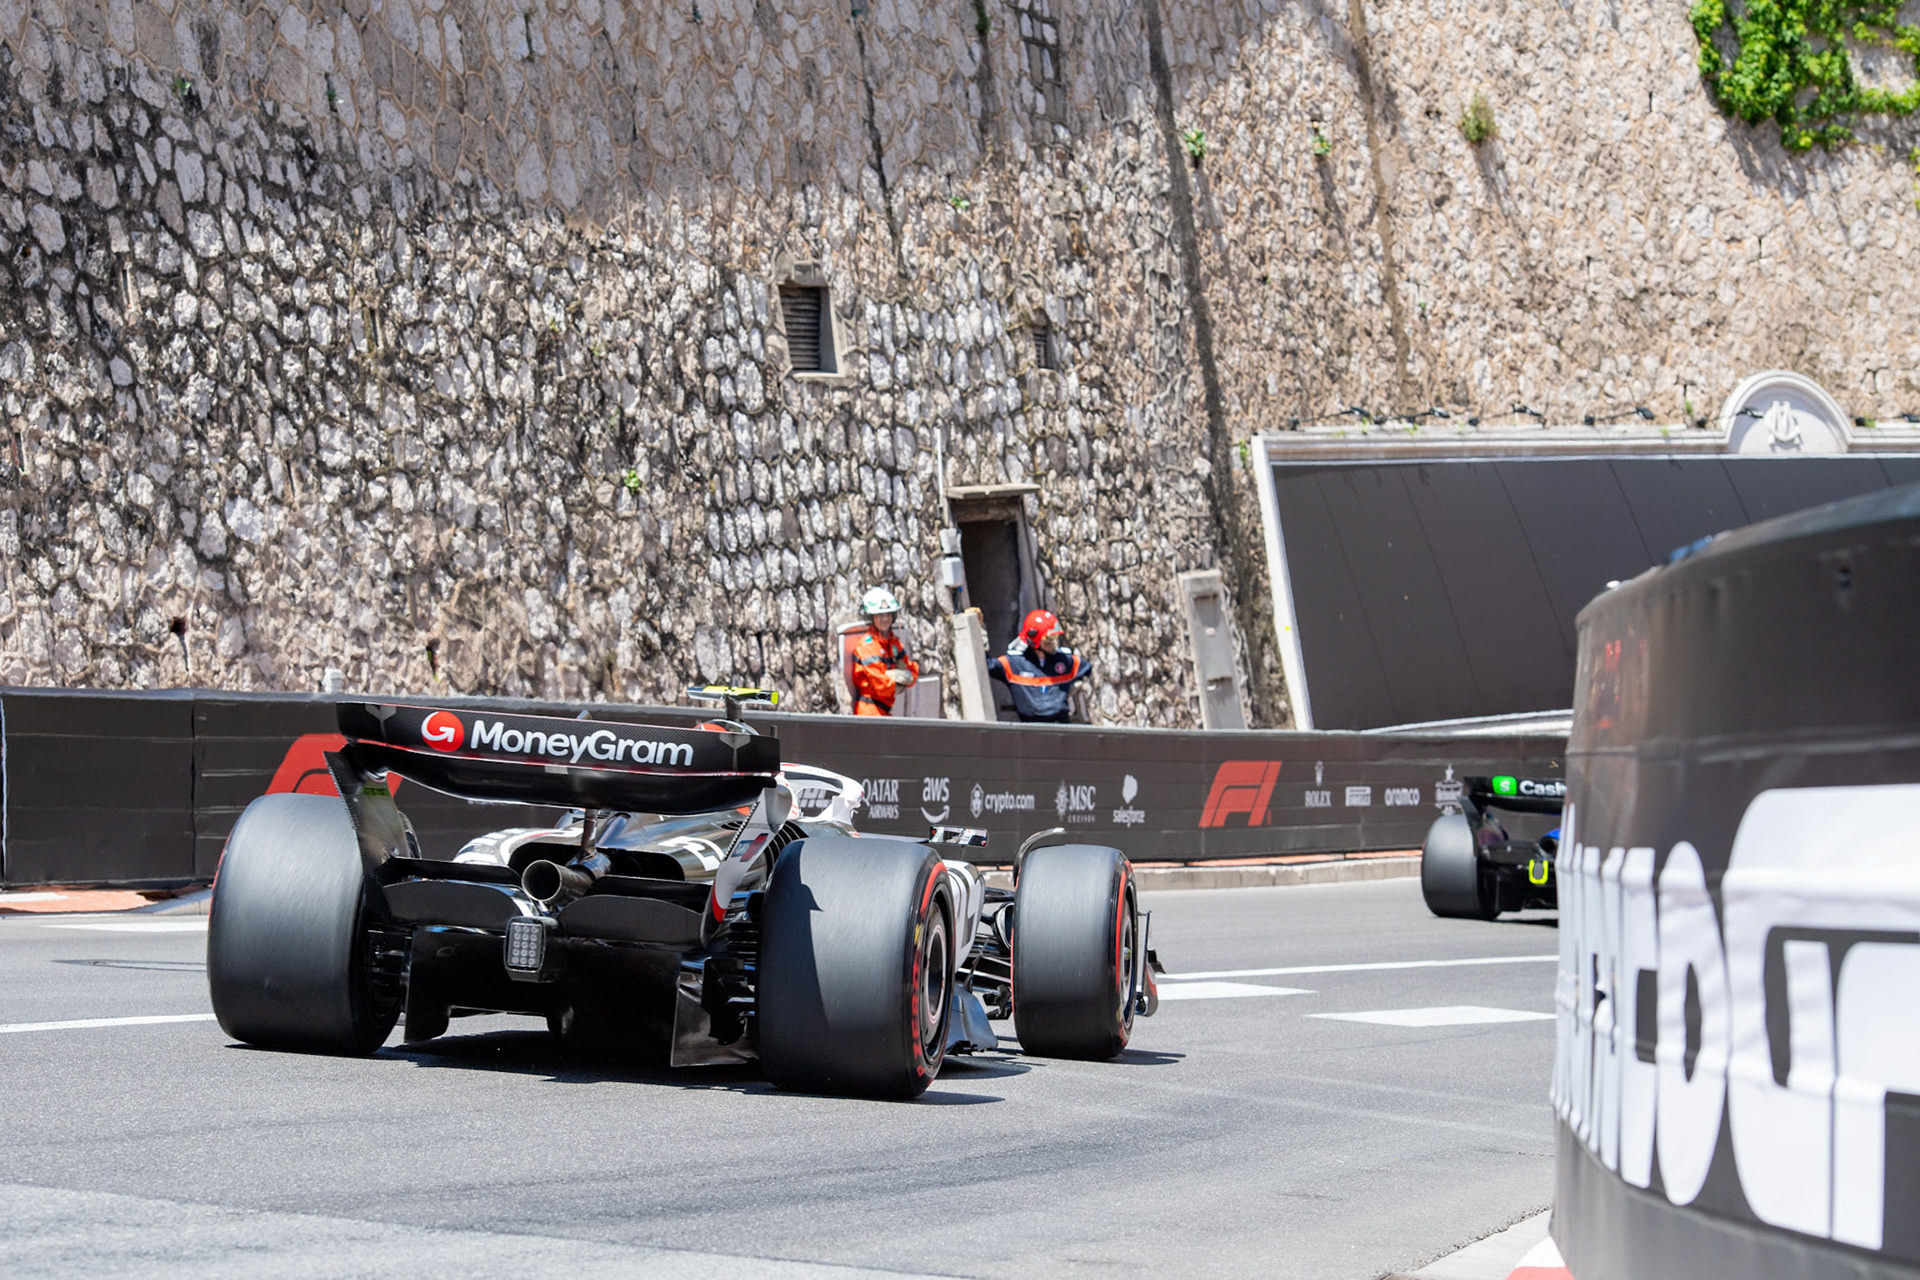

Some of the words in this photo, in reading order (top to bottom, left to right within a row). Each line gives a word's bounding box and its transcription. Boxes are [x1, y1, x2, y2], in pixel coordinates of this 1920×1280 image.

[471, 719, 694, 765] MoneyGram
[862, 778, 899, 807] QATAR
[922, 777, 950, 802] aws
[1068, 785, 1096, 811] MSC
[1304, 790, 1332, 808] ROLEX
[1384, 787, 1420, 806] aramco
[1520, 780, 1568, 796] Cash
[984, 791, 1035, 814] crypto.com
[1112, 805, 1145, 827] salesforce
